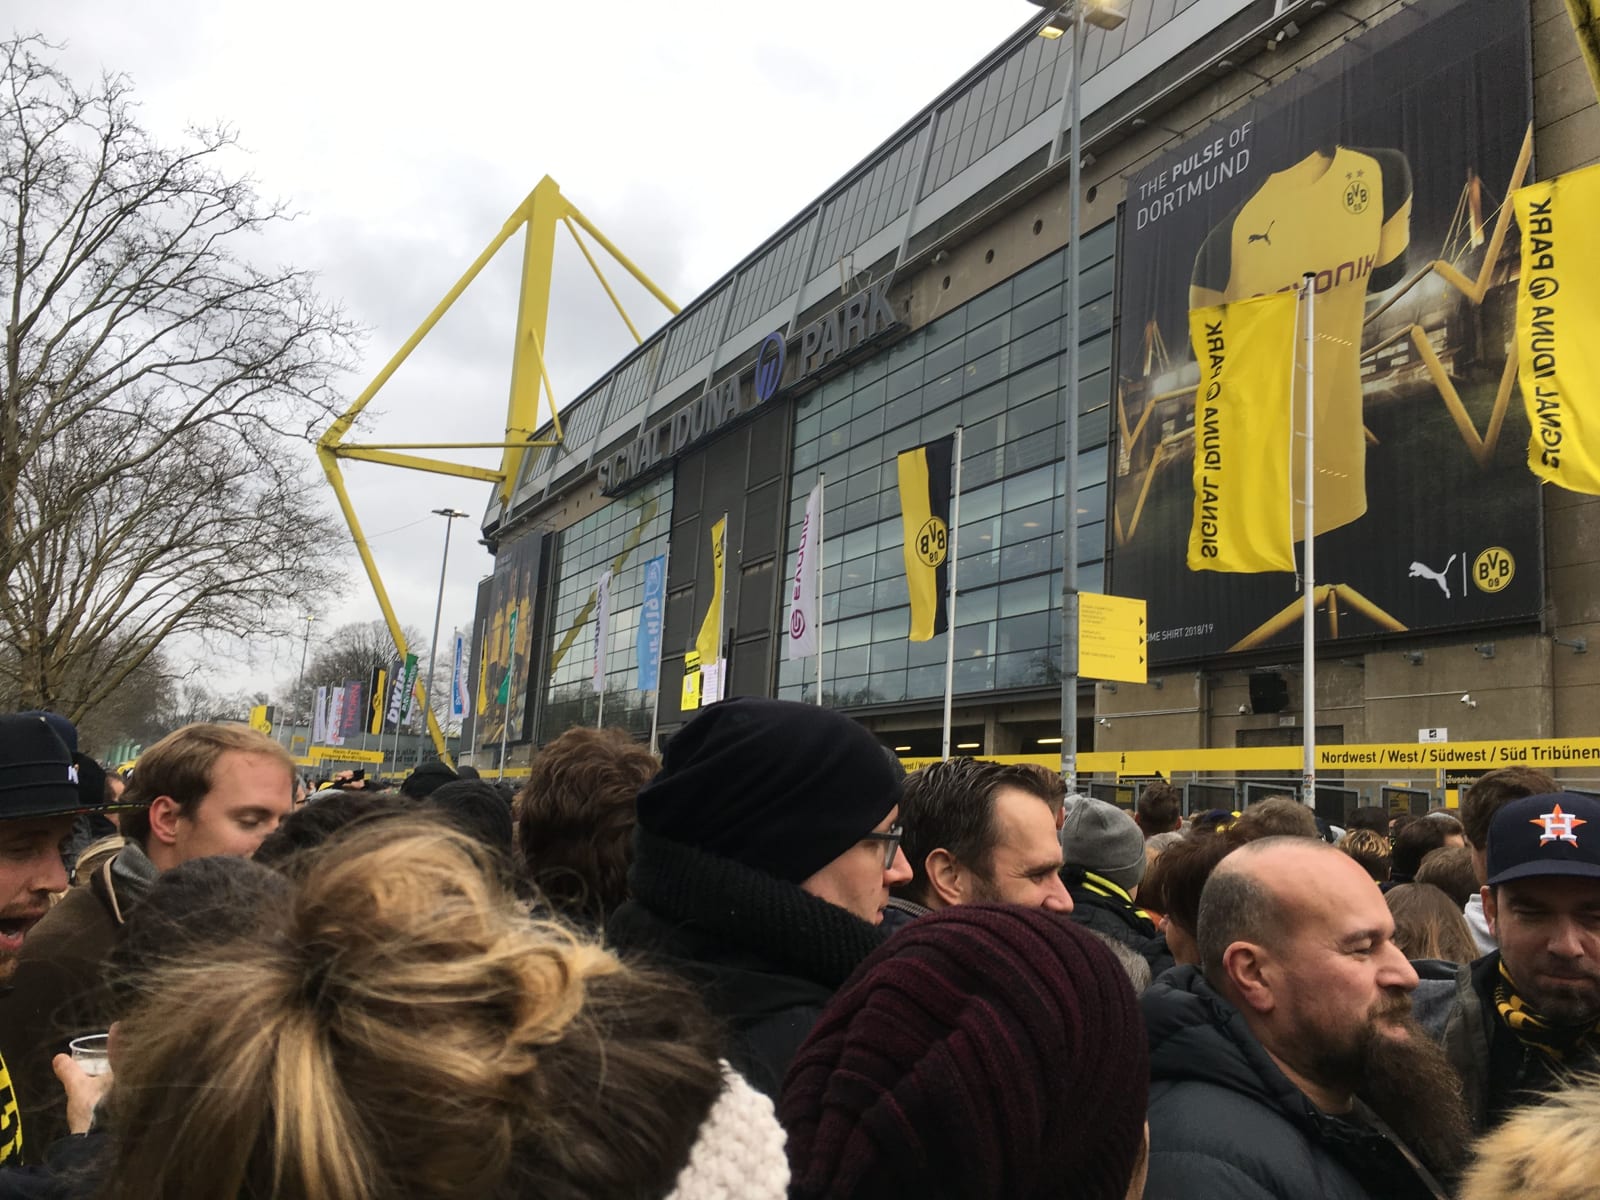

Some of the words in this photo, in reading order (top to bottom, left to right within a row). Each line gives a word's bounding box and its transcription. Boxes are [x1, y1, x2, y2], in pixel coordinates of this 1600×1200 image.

[1139, 171, 1168, 200] THE
[1172, 137, 1225, 183] PULSE
[1229, 120, 1253, 148] OF
[1137, 149, 1250, 231] DORTMUND
[1347, 183, 1367, 206] BVB
[597, 425, 663, 497] SIGNAL
[668, 374, 742, 456] IDUNA
[801, 283, 897, 375] PARK
[1479, 551, 1510, 580] BVB
[1488, 577, 1500, 588] 09
[1146, 631, 1160, 642] OME
[1161, 627, 1184, 641] SHIRT
[1184, 623, 1214, 637] 2018/19
[1321, 751, 1376, 763] Nordwest
[1379, 748, 1386, 764] /
[1387, 750, 1418, 763] West
[1420, 748, 1427, 764] /
[1430, 748, 1487, 762] Südwest
[1490, 746, 1497, 762] /
[1500, 746, 1527, 761] Süd
[1531, 744, 1600, 760] Tribünen
